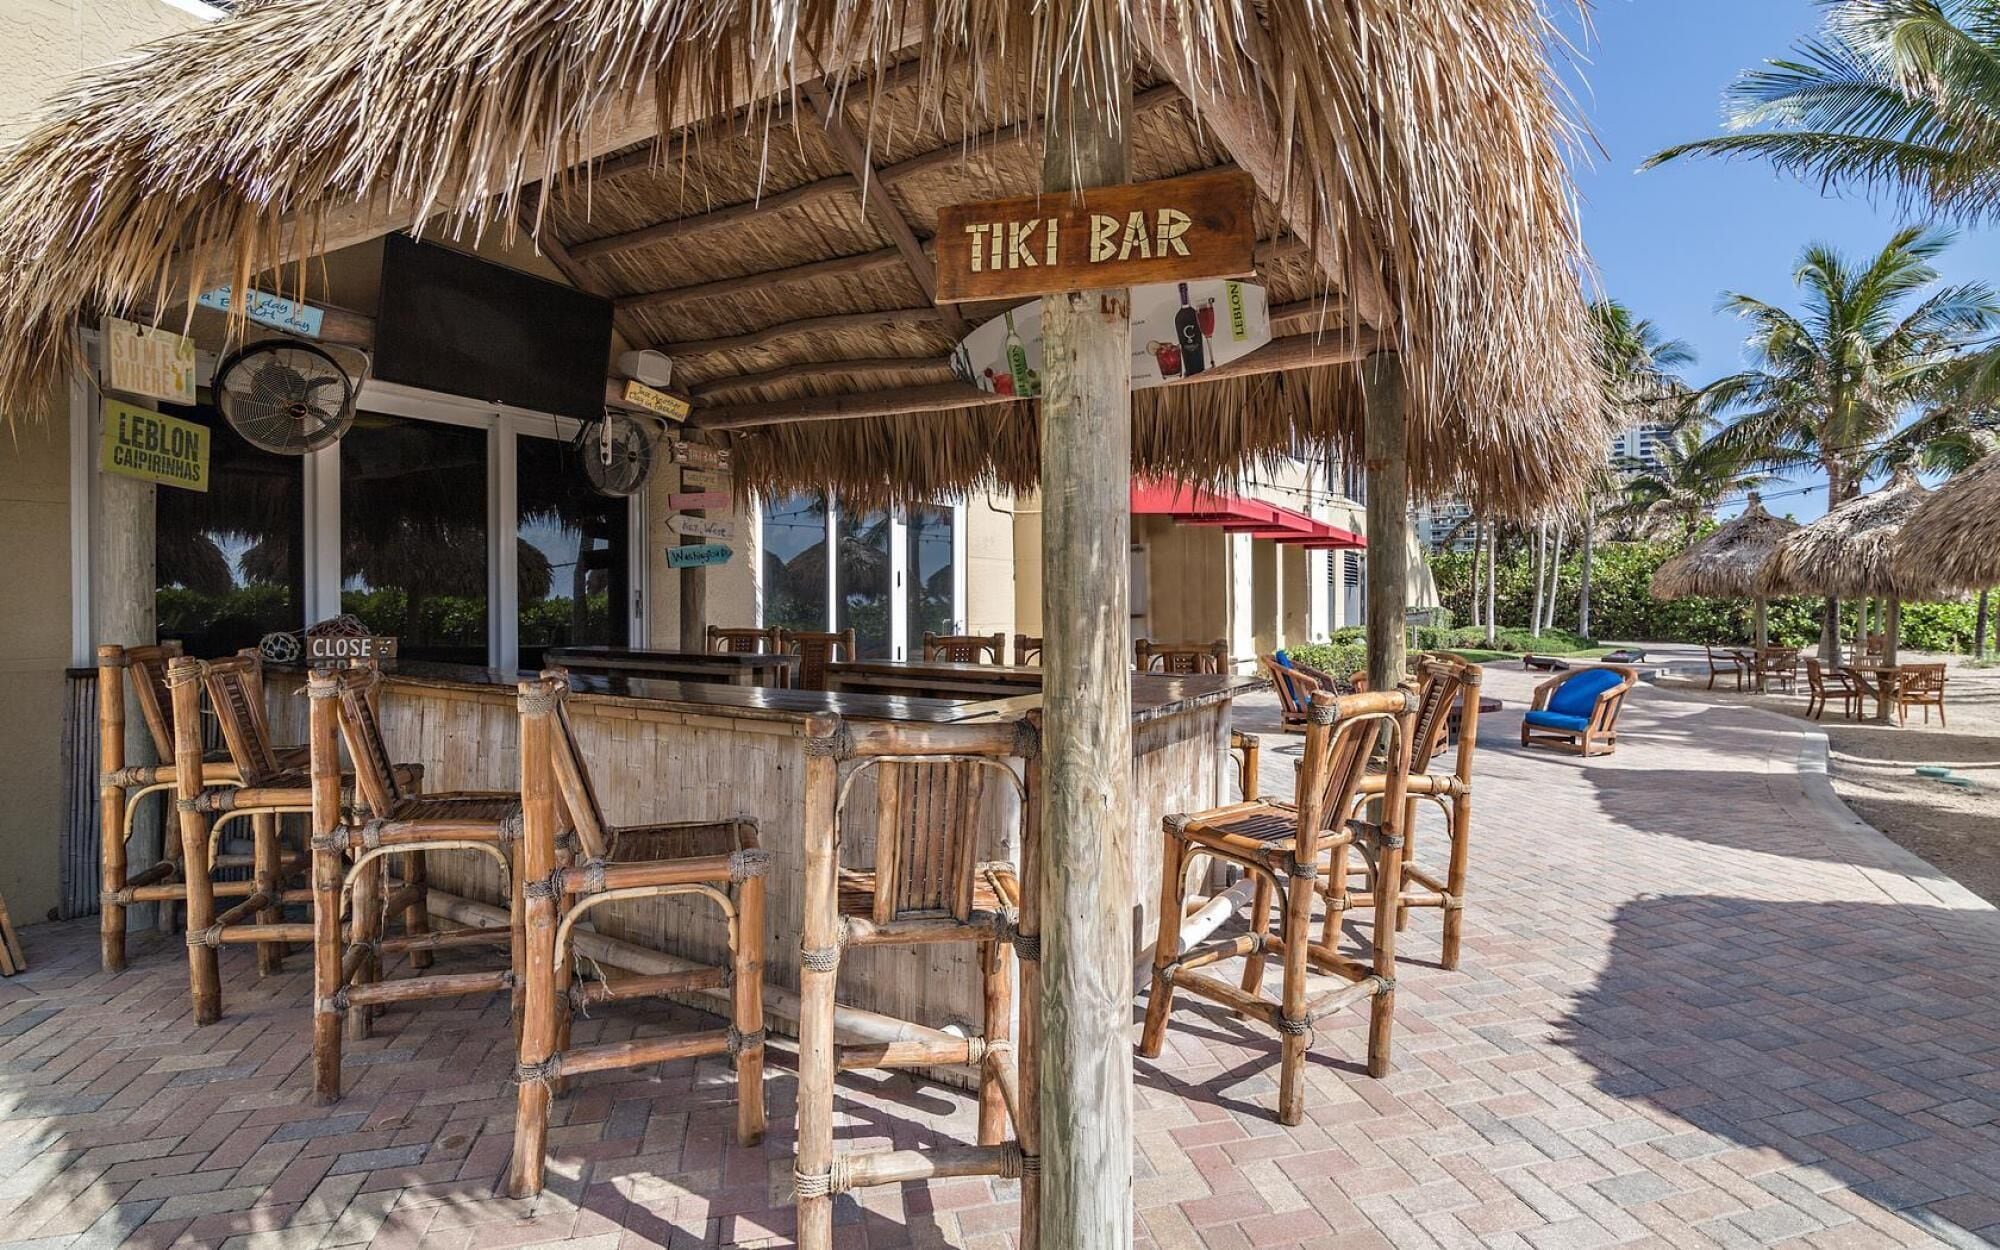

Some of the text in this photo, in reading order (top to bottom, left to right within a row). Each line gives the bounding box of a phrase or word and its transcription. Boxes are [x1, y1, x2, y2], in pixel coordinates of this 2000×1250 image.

[965, 208, 1192, 272] TIKI BAR
[1230, 284, 1246, 336] LEBLON
[113, 331, 170, 370] SOME
[114, 359, 171, 396] WHERE
[118, 412, 200, 462] LEBLON
[113, 445, 200, 482] CAIPIRINHAS
